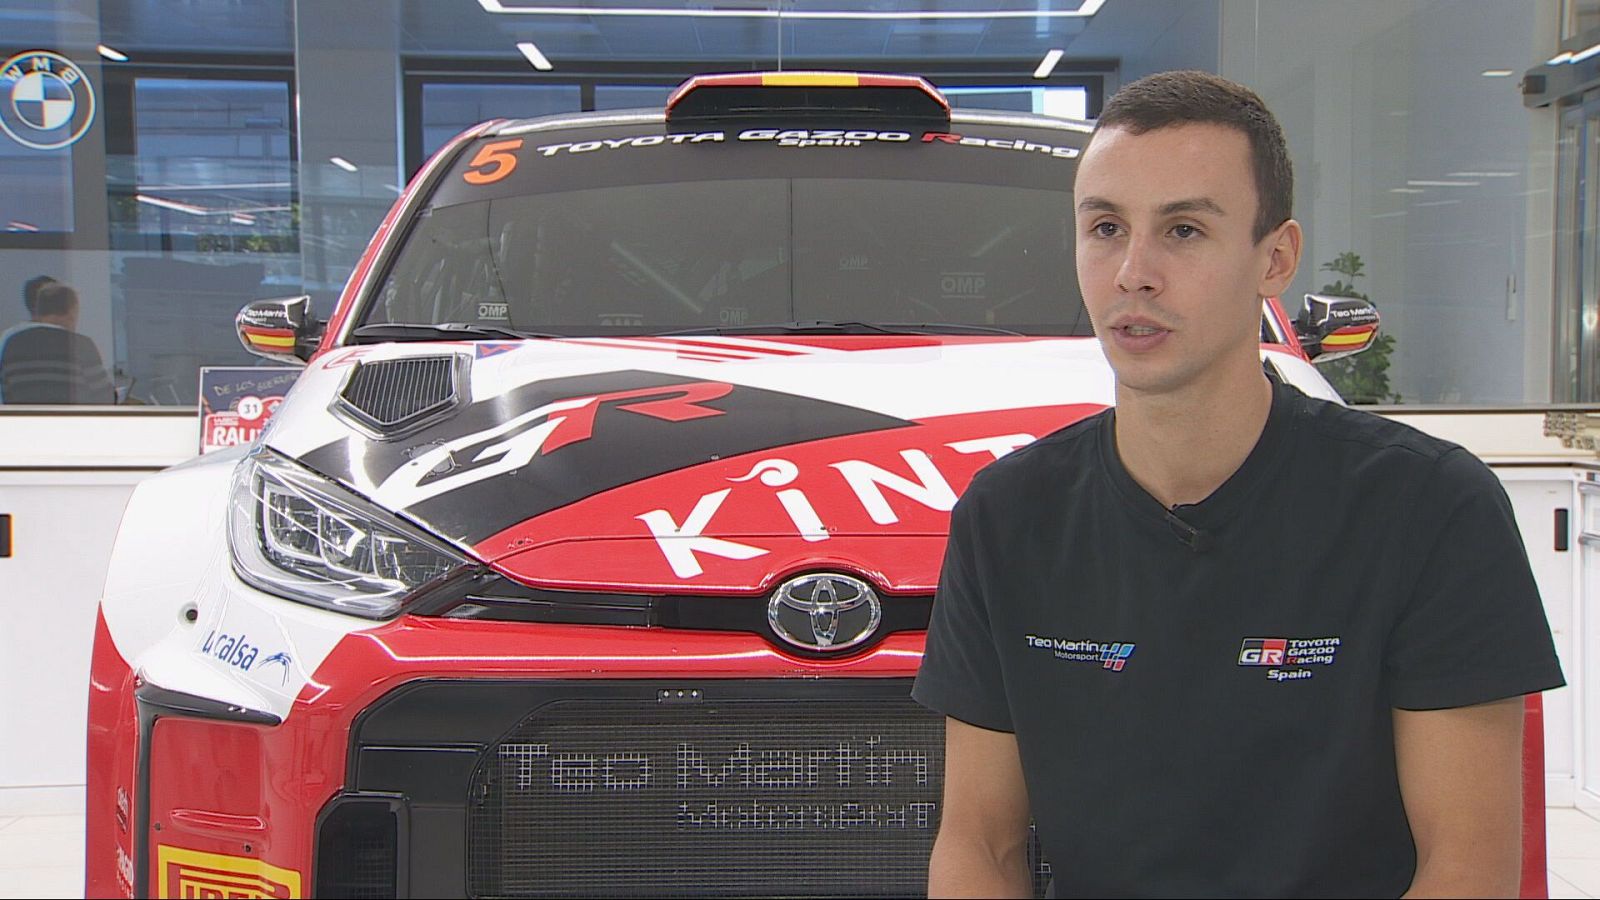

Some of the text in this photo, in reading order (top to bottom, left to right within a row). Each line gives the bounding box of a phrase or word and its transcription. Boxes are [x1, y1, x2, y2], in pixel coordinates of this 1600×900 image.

[537, 129, 1080, 158] TOYOTA GAZOO Racing
[778, 138, 862, 148] Spain
[463, 138, 524, 185] 5
[940, 276, 986, 293] OMP
[477, 305, 507, 317] OMP
[244, 403, 258, 414] 31
[371, 382, 733, 511] GR
[1025, 635, 1052, 647] Teo
[1289, 638, 1340, 648] TOYOTA
[1054, 650, 1099, 661] Motorsport
[1241, 649, 1283, 663] GR
[1287, 647, 1335, 656] GAZOO
[1286, 655, 1333, 664] Racing
[1267, 669, 1312, 681] Spain
[498, 743, 650, 791] Teo
